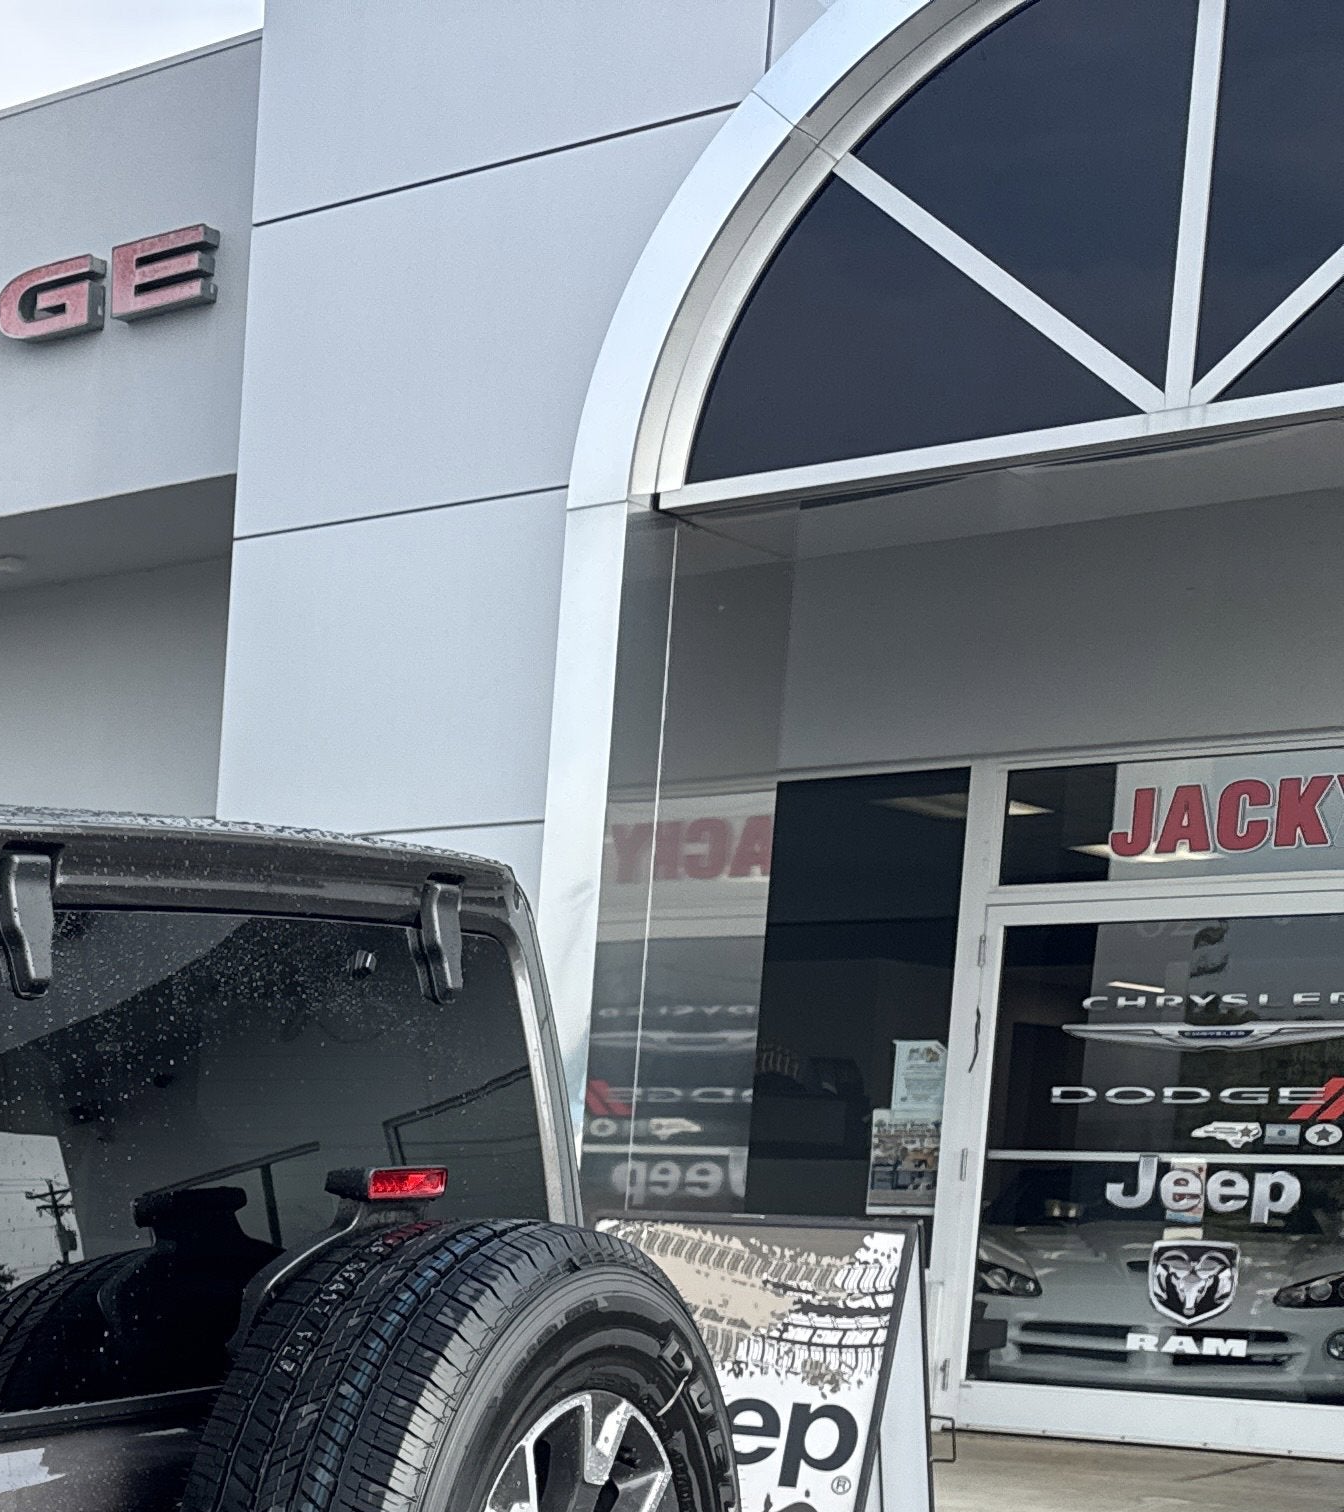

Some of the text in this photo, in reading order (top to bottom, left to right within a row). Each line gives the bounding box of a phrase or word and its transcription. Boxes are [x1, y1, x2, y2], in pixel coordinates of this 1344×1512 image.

[1109, 773, 1344, 858] JACK
[1051, 1086, 1326, 1105] DODGE
[1105, 1154, 1302, 1225] Jeep
[1125, 1332, 1248, 1358] RAM
[725, 1397, 859, 1489] ep
